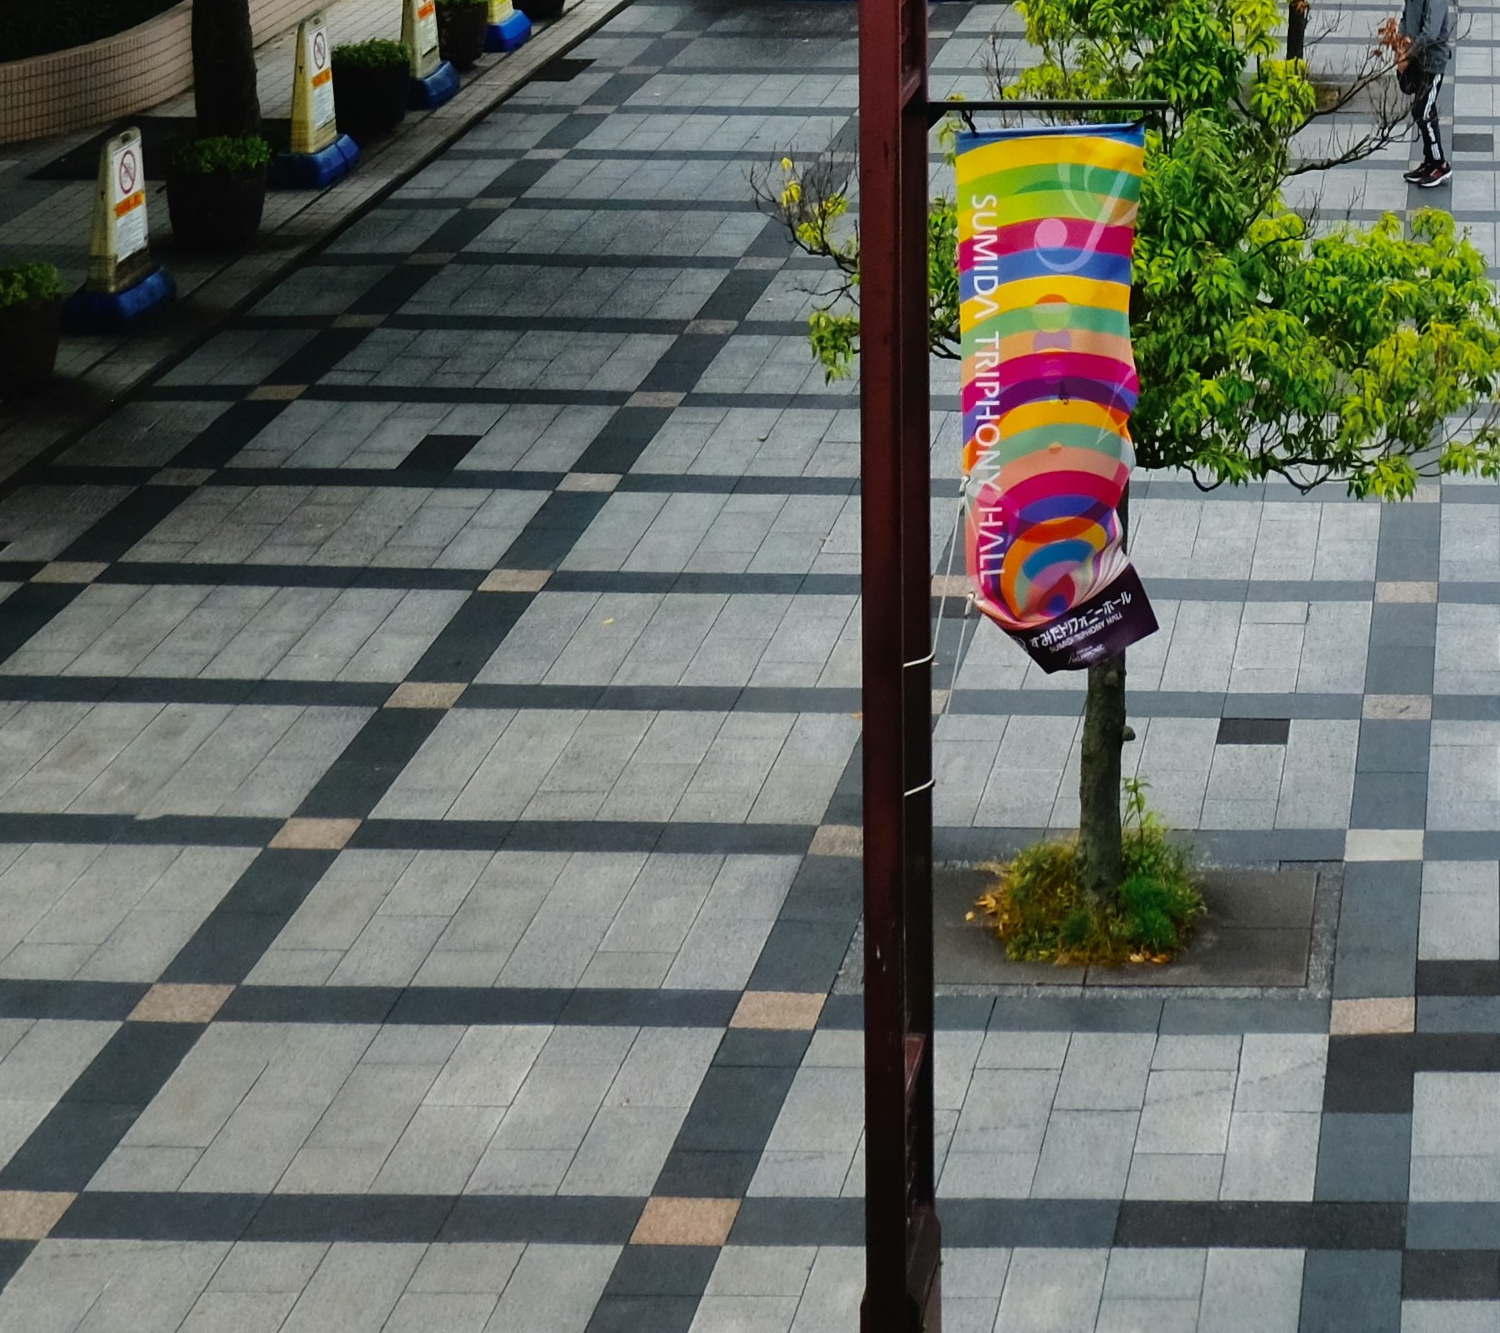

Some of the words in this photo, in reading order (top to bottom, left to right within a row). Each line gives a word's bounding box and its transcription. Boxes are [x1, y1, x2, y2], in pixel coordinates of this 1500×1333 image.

[971, 194, 1000, 320] SUMIDA
[974, 331, 1002, 493] TRIPHONY
[977, 506, 1006, 585] HALL
